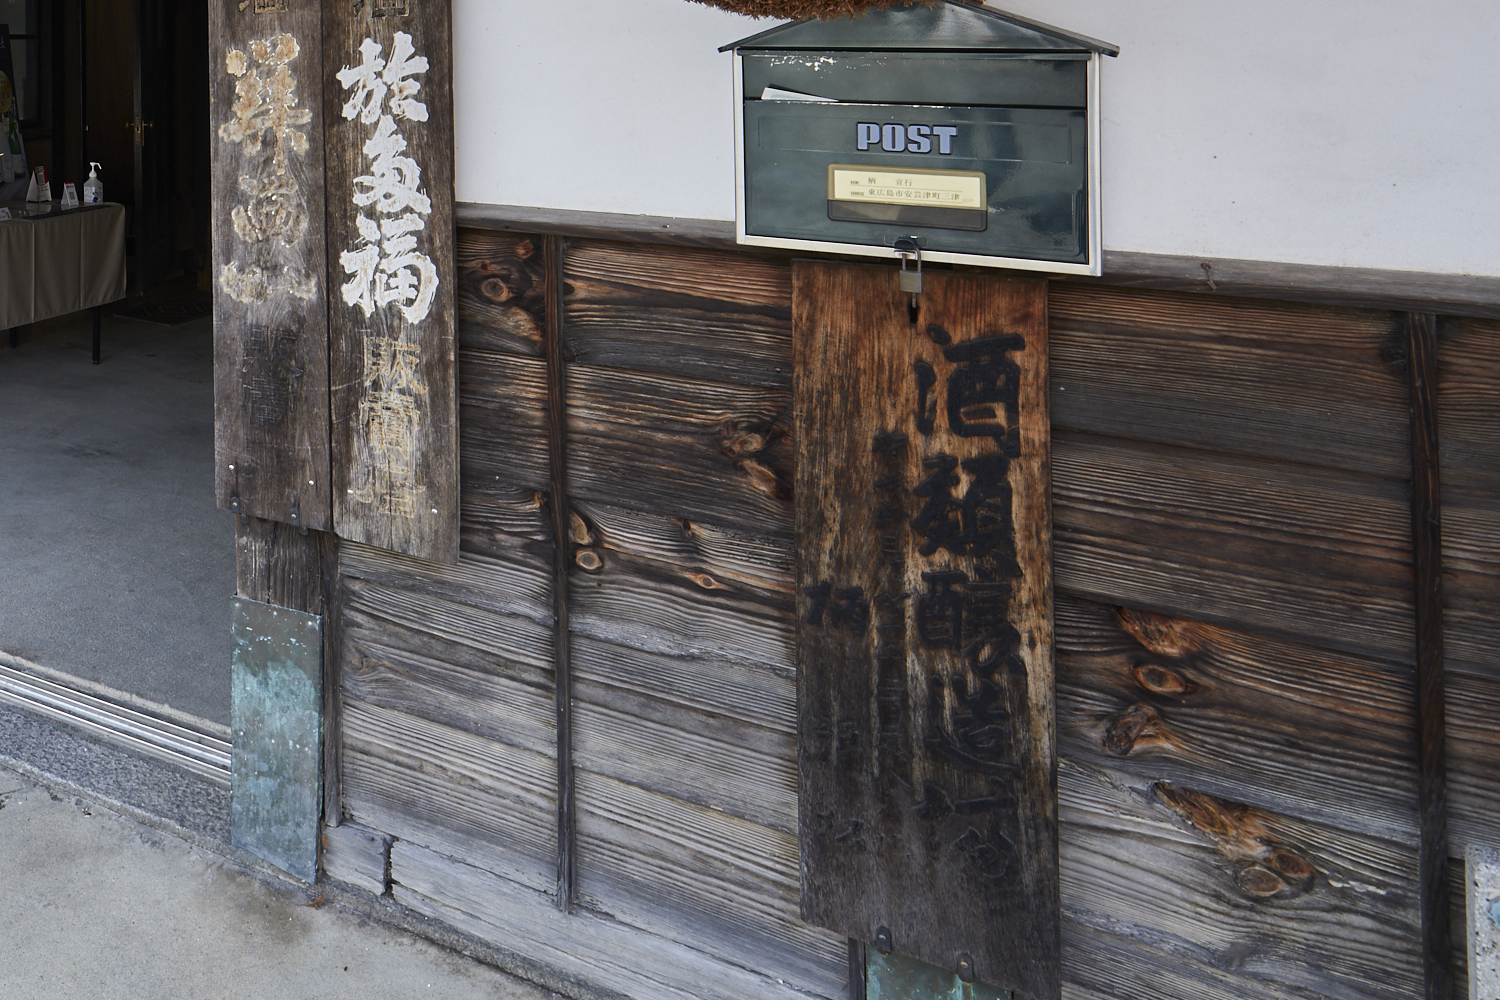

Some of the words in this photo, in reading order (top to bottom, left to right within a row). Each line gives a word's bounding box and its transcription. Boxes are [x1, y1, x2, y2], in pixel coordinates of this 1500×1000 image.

[857, 122, 958, 155] POST
[868, 188, 960, 201] 東広島市安芸津町三津
